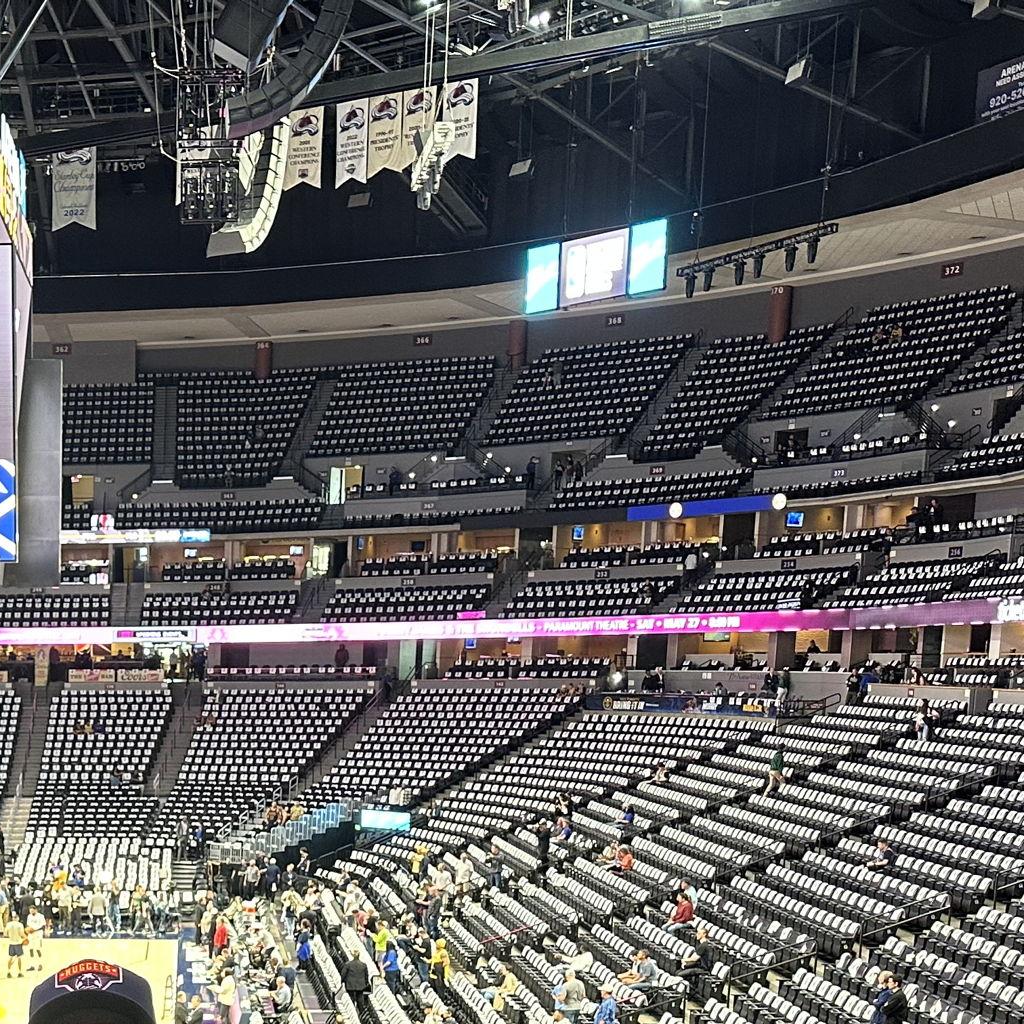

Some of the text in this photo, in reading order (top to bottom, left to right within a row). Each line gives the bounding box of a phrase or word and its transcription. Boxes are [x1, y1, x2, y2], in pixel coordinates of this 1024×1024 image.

[340, 140, 364, 149] WESTERN
[288, 152, 320, 160] CONFERENCE
[64, 209, 85, 217] 2022
[944, 265, 960, 276] 372
[608, 316, 622, 325] 368
[415, 336, 430, 344] 366
[55, 345, 69, 353] 362
[544, 620, 594, 632] PARAMOUNT
[595, 619, 629, 630] THEATRE
[64, 962, 111, 977] NUGGETS
